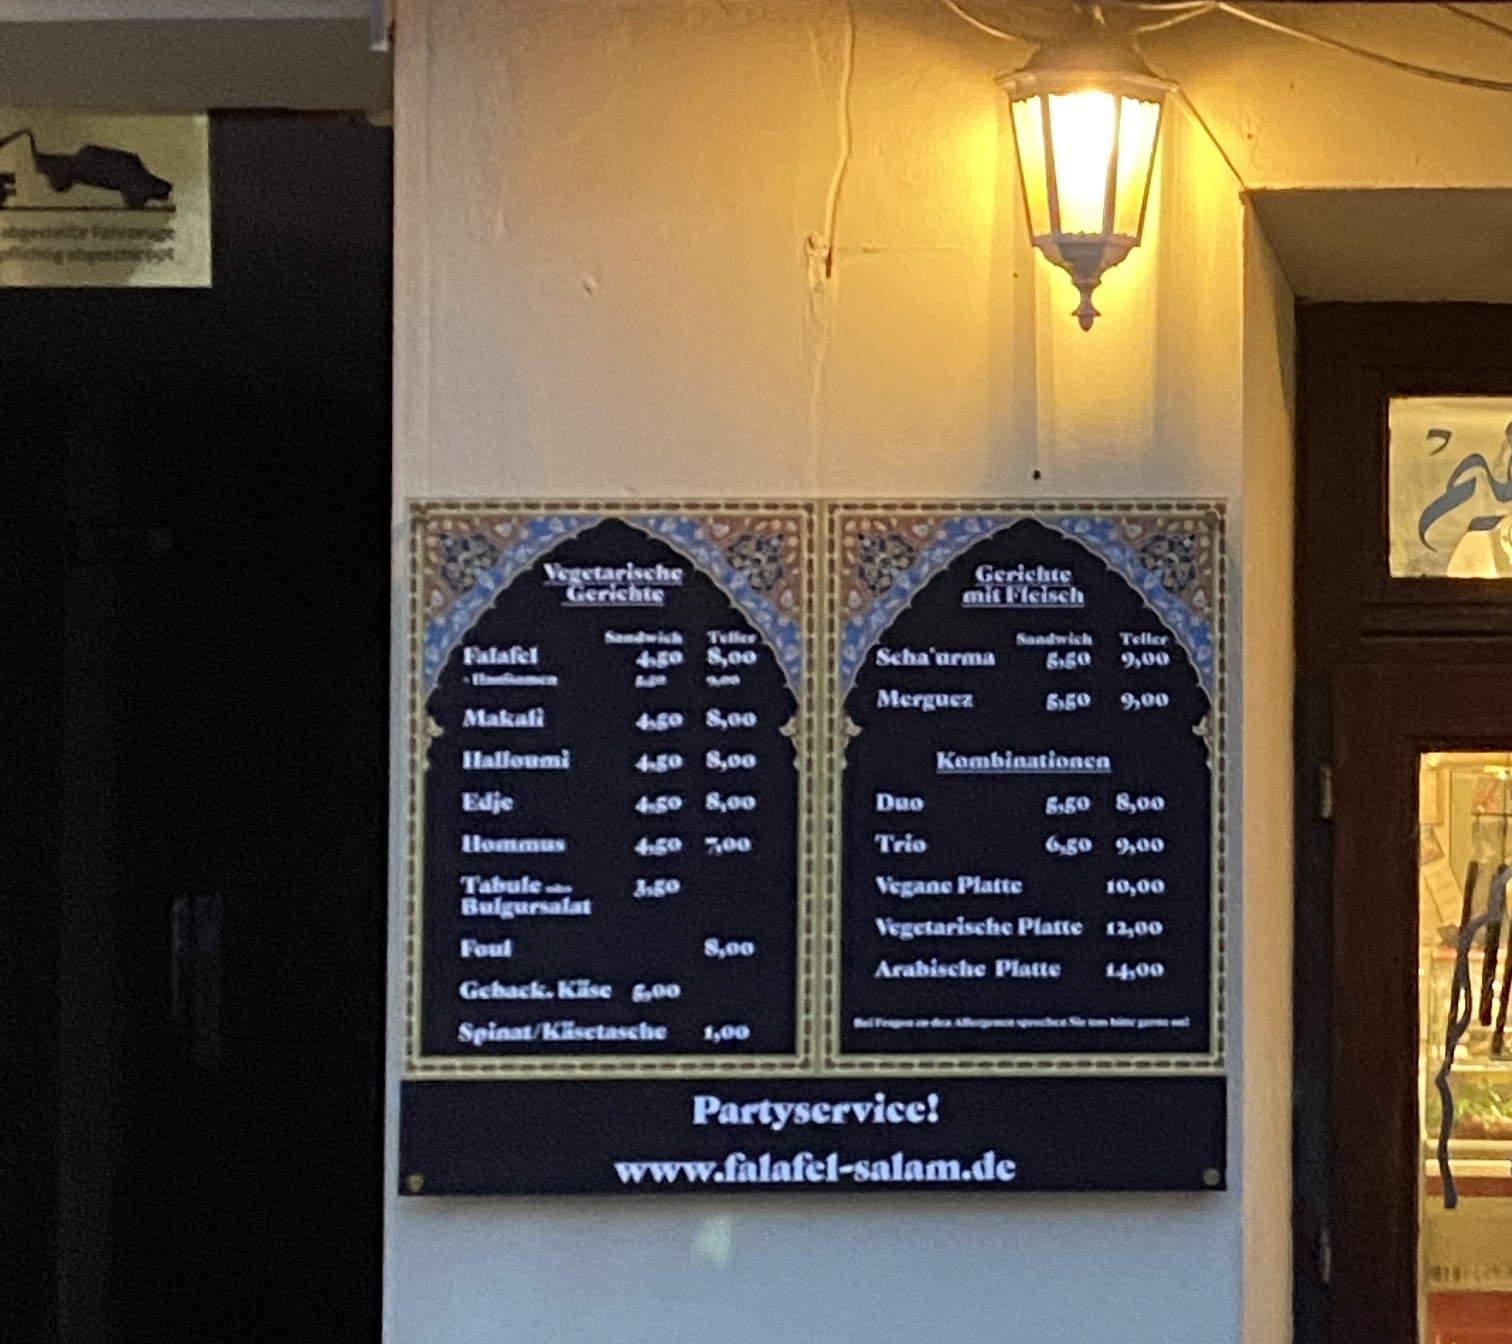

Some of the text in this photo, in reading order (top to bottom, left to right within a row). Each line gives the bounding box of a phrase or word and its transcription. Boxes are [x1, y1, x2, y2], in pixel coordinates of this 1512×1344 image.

[544, 562, 683, 584] Vegetarische
[976, 564, 1071, 584] Gerichte
[565, 584, 664, 604] Gerichte
[963, 584, 1084, 605] mit Fleisch
[605, 629, 757, 644] Sandwich Teller
[1017, 632, 1168, 645] Sandwich Teller
[464, 646, 757, 668] Falafel 4,50 8,00
[1047, 651, 1091, 669] 5,50
[1121, 652, 1169, 668] 9,00
[877, 690, 1169, 712] Merguez 5,50 9,00
[636, 713, 683, 730] 4,50
[706, 709, 757, 729] 8,00
[463, 749, 756, 772] Halloumi 4,50 8,00
[937, 750, 1110, 771] Kombinationen
[463, 791, 756, 814] Edje 4,50 8,00
[877, 793, 1164, 814] Duo 5,50 8,00
[462, 835, 751, 855] Hommus 4,50 7,00
[875, 833, 1164, 855] Trio 6,50 9,00
[460, 876, 541, 894] Tabule
[634, 879, 680, 897] 3,50
[876, 876, 1165, 898] Vegane Platte 10,00
[462, 897, 591, 919] Bulgursalat
[875, 916, 1163, 940] Vegetarische Platte 12,00
[461, 938, 754, 958] Foul 8,00
[875, 958, 1164, 980] Arabische Platte 14,00
[558, 979, 612, 999] Käse
[632, 984, 681, 1002] 5,00
[458, 1021, 750, 1046] Spinat/Käsetasche 1,00
[693, 1092, 938, 1131] Partyservice!
[614, 1151, 1015, 1183] www.falafel-salam.de
